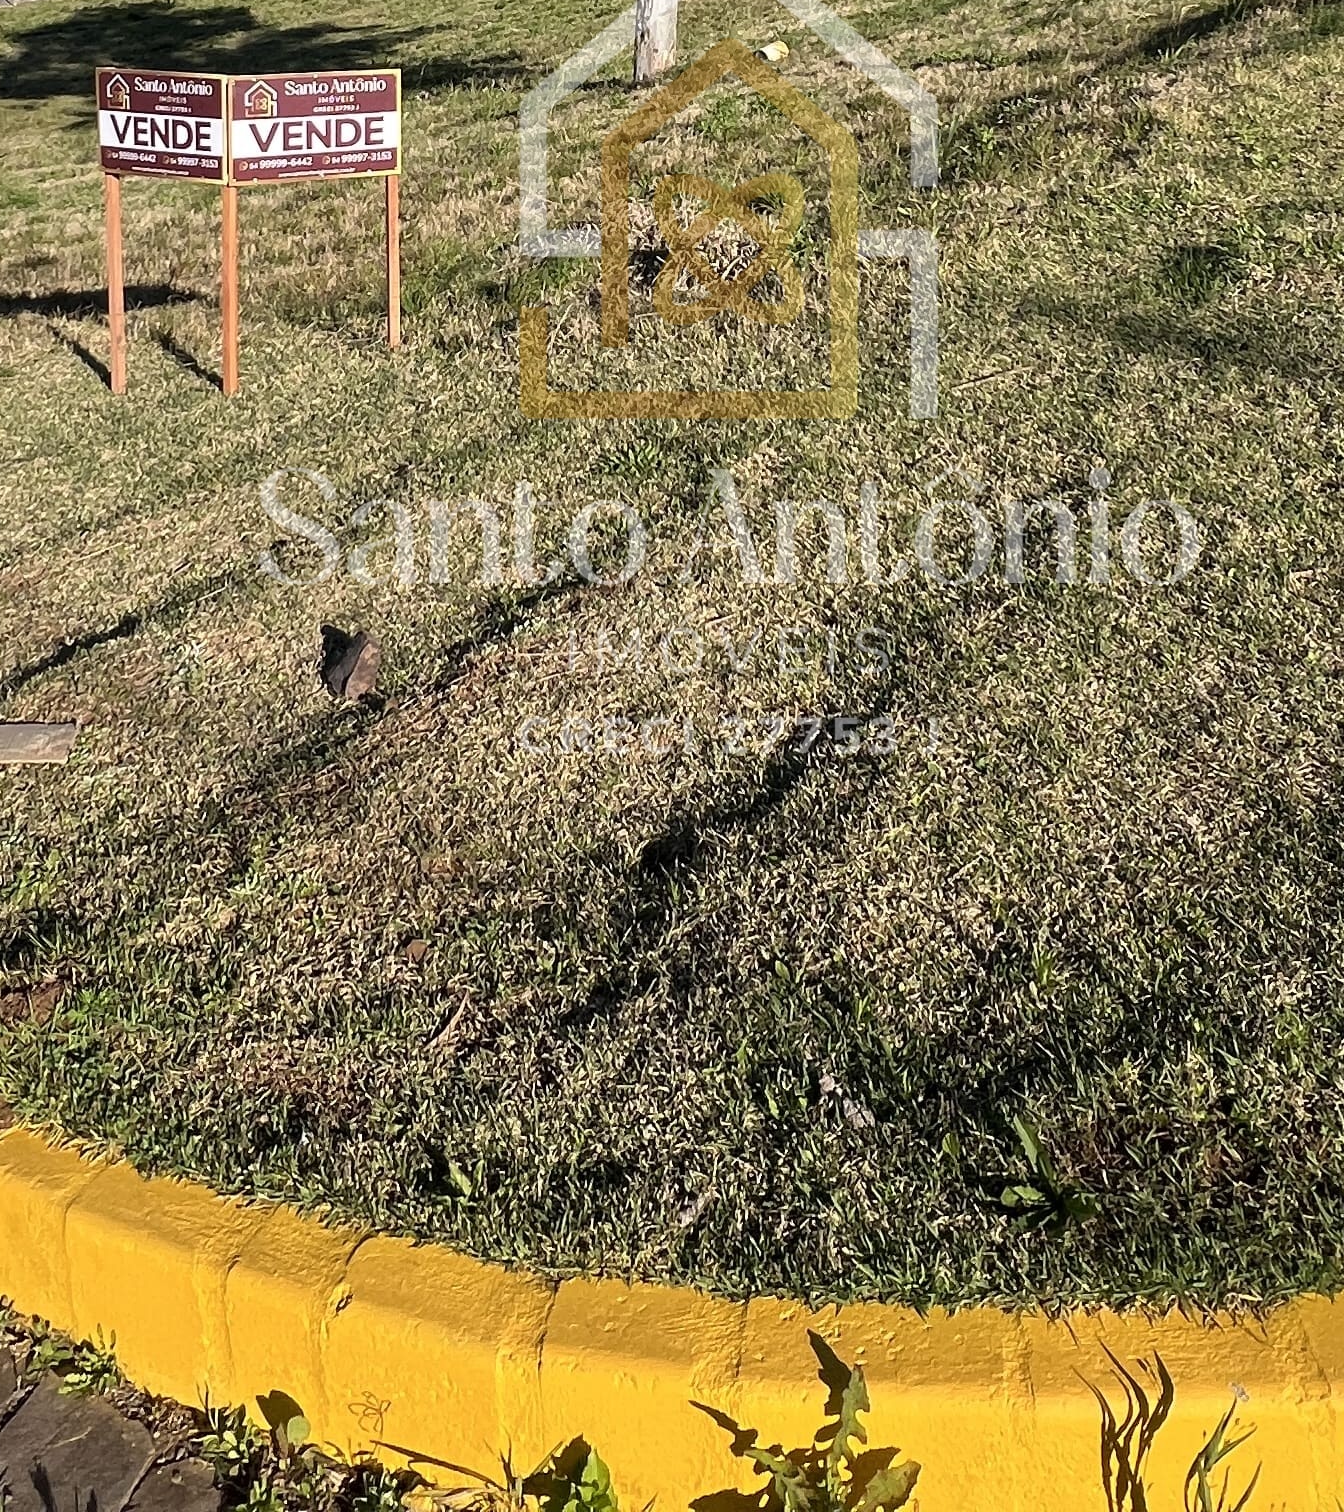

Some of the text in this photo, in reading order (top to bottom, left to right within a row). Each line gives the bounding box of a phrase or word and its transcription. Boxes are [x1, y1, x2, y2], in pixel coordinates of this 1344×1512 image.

[134, 76, 213, 96] Santo Antônio
[284, 76, 387, 96] Santo Antônio
[110, 114, 212, 152] VENDE
[248, 116, 384, 153] VENDE
